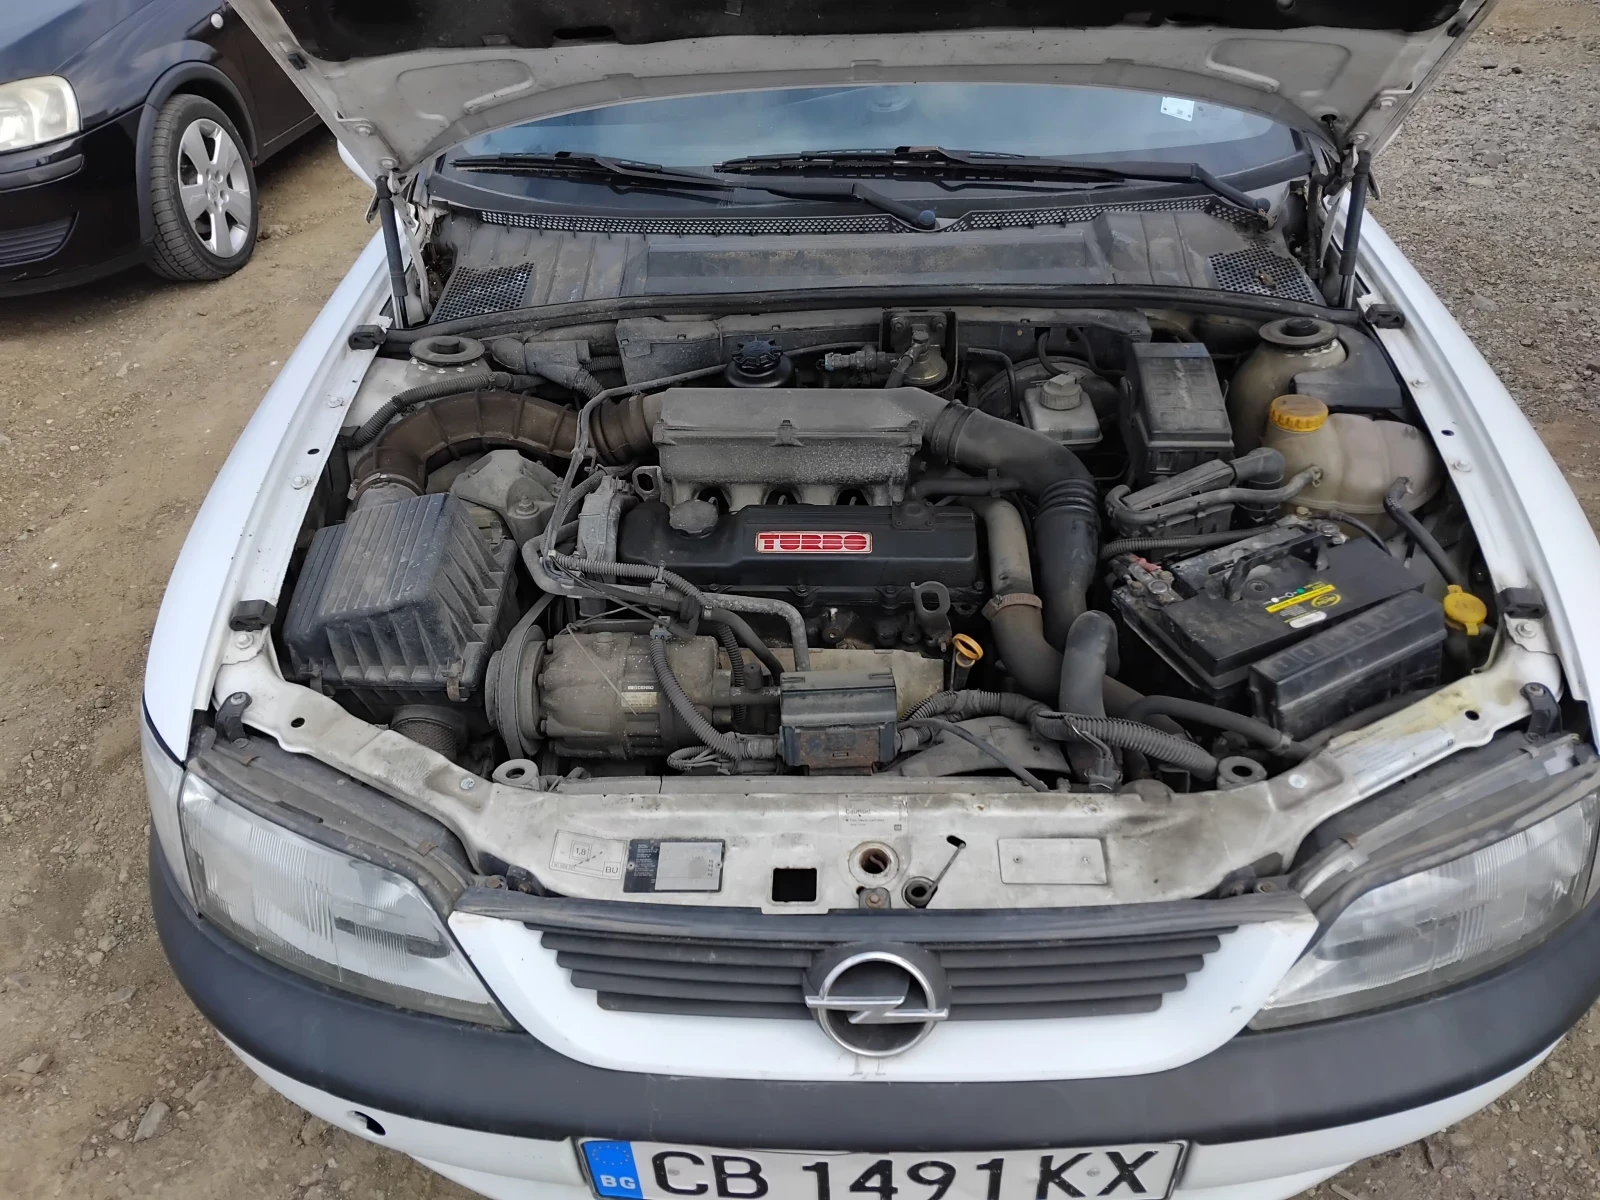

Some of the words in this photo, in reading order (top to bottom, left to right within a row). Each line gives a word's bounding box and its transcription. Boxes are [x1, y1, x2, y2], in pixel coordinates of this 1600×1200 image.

[759, 534, 867, 551] TURBO
[605, 866, 619, 874] BU
[600, 1174, 636, 1190] BG
[652, 1150, 769, 1199] CB
[802, 1158, 1005, 1200] 1491
[1036, 1150, 1160, 1200] KX
